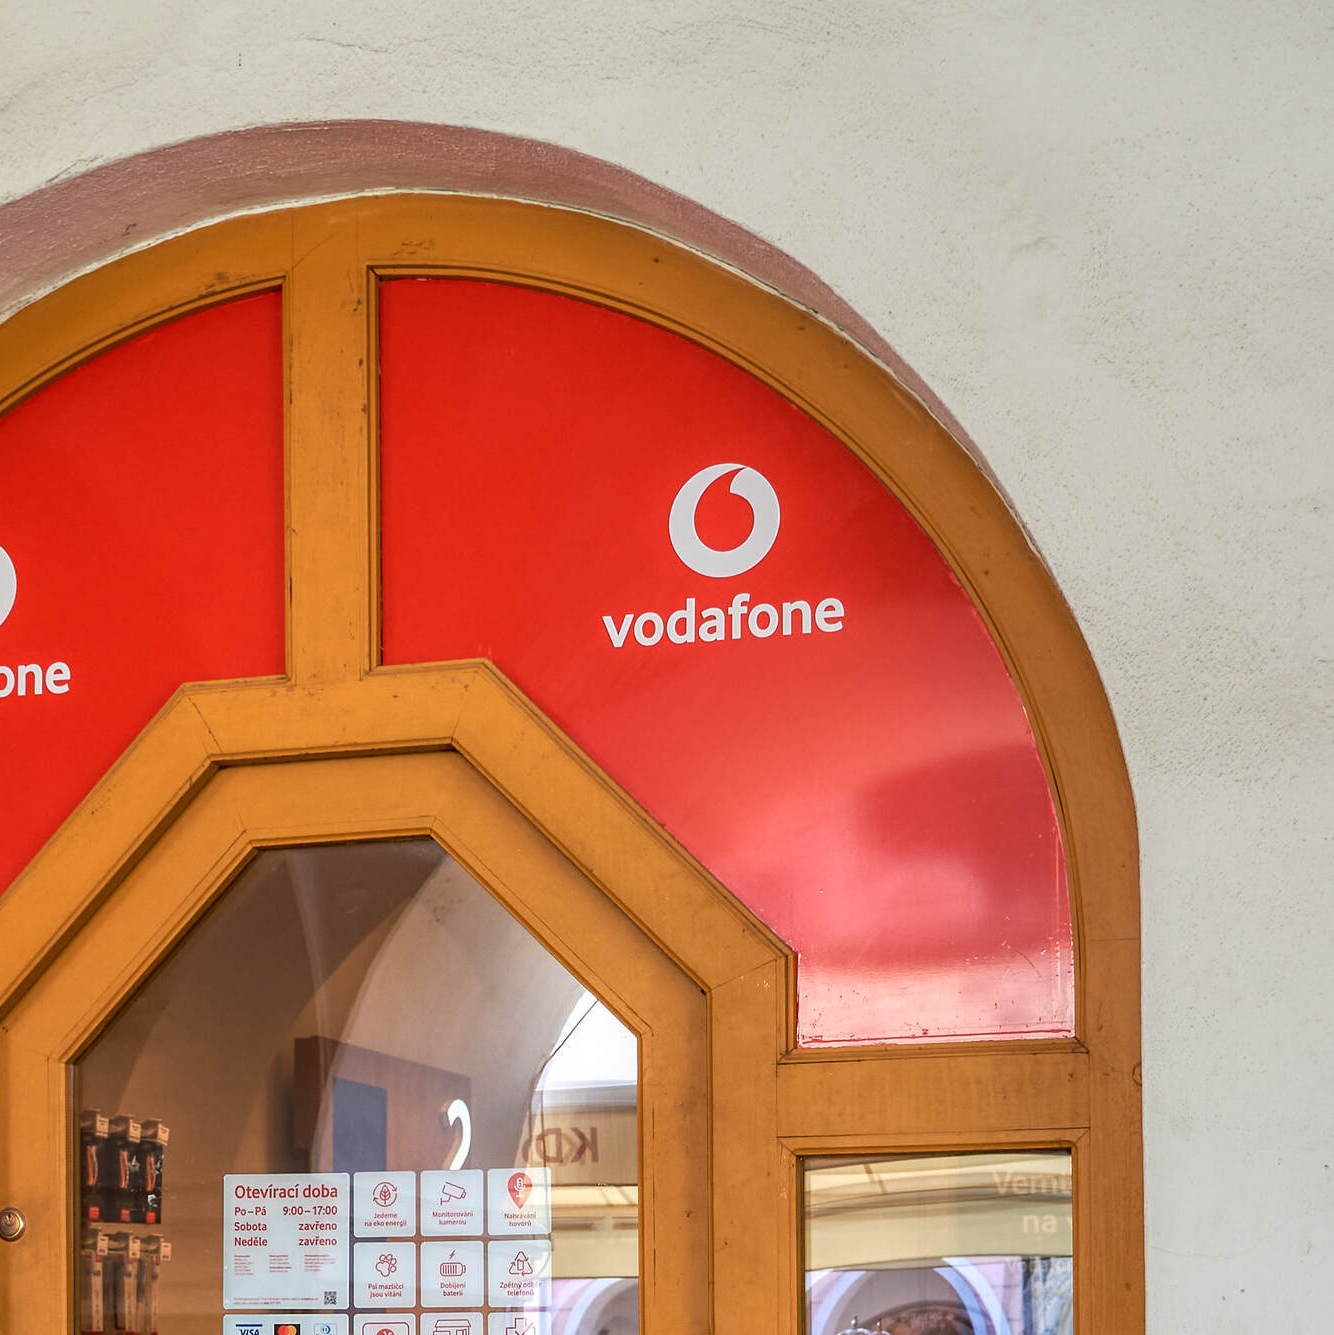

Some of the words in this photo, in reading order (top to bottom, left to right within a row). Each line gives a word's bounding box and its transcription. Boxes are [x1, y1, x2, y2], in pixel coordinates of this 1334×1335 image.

[602, 592, 845, 648] vodafone
[234, 1184, 299, 1199] Otevírací
[302, 1184, 338, 1198] doba
[234, 1222, 267, 1232] Sobota
[298, 1220, 338, 1231] zavřeno
[234, 1237, 268, 1247] Neděle
[298, 1236, 338, 1246] zavřeno
